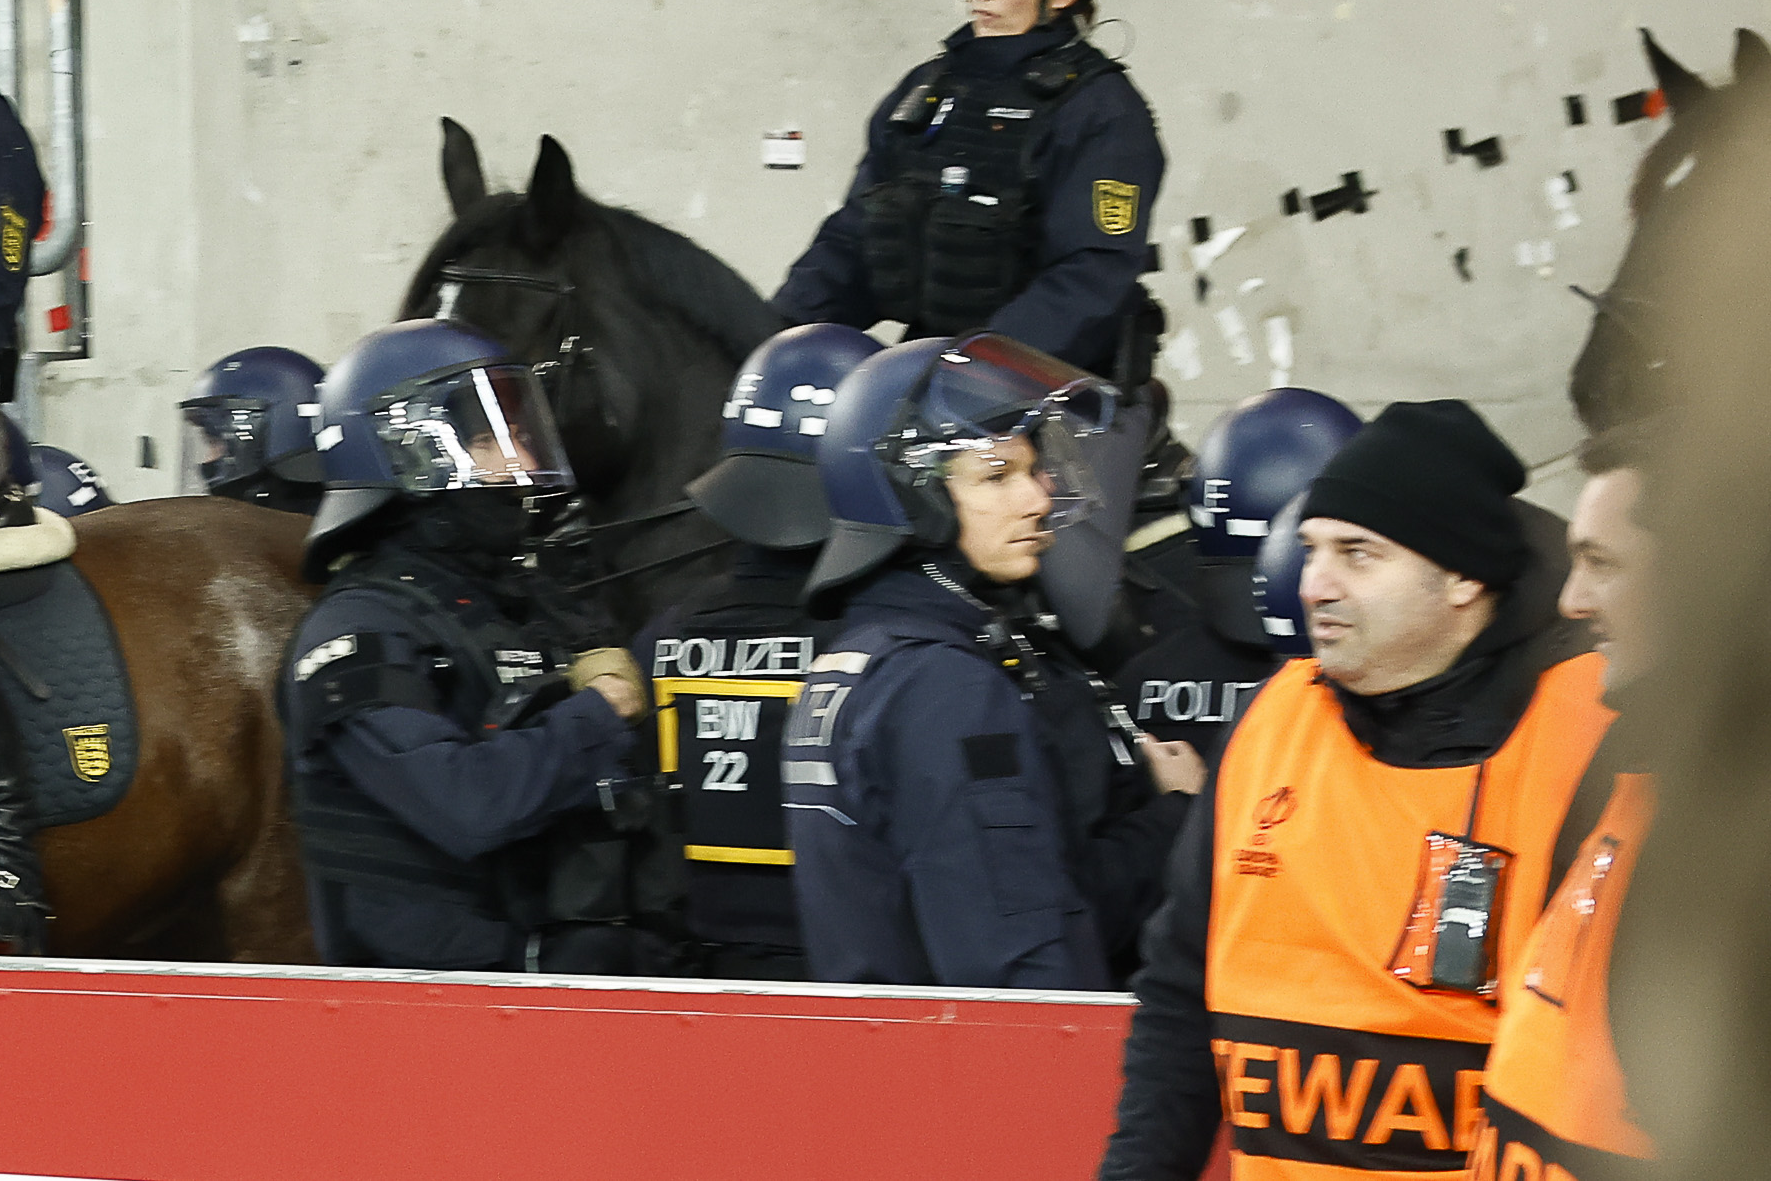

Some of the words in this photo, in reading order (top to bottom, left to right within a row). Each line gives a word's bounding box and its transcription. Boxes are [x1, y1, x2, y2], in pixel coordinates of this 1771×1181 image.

[652, 636, 815, 676] POLIZEI
[695, 699, 762, 740] BW
[1137, 680, 1261, 722] POLI
[701, 750, 749, 791] 22
